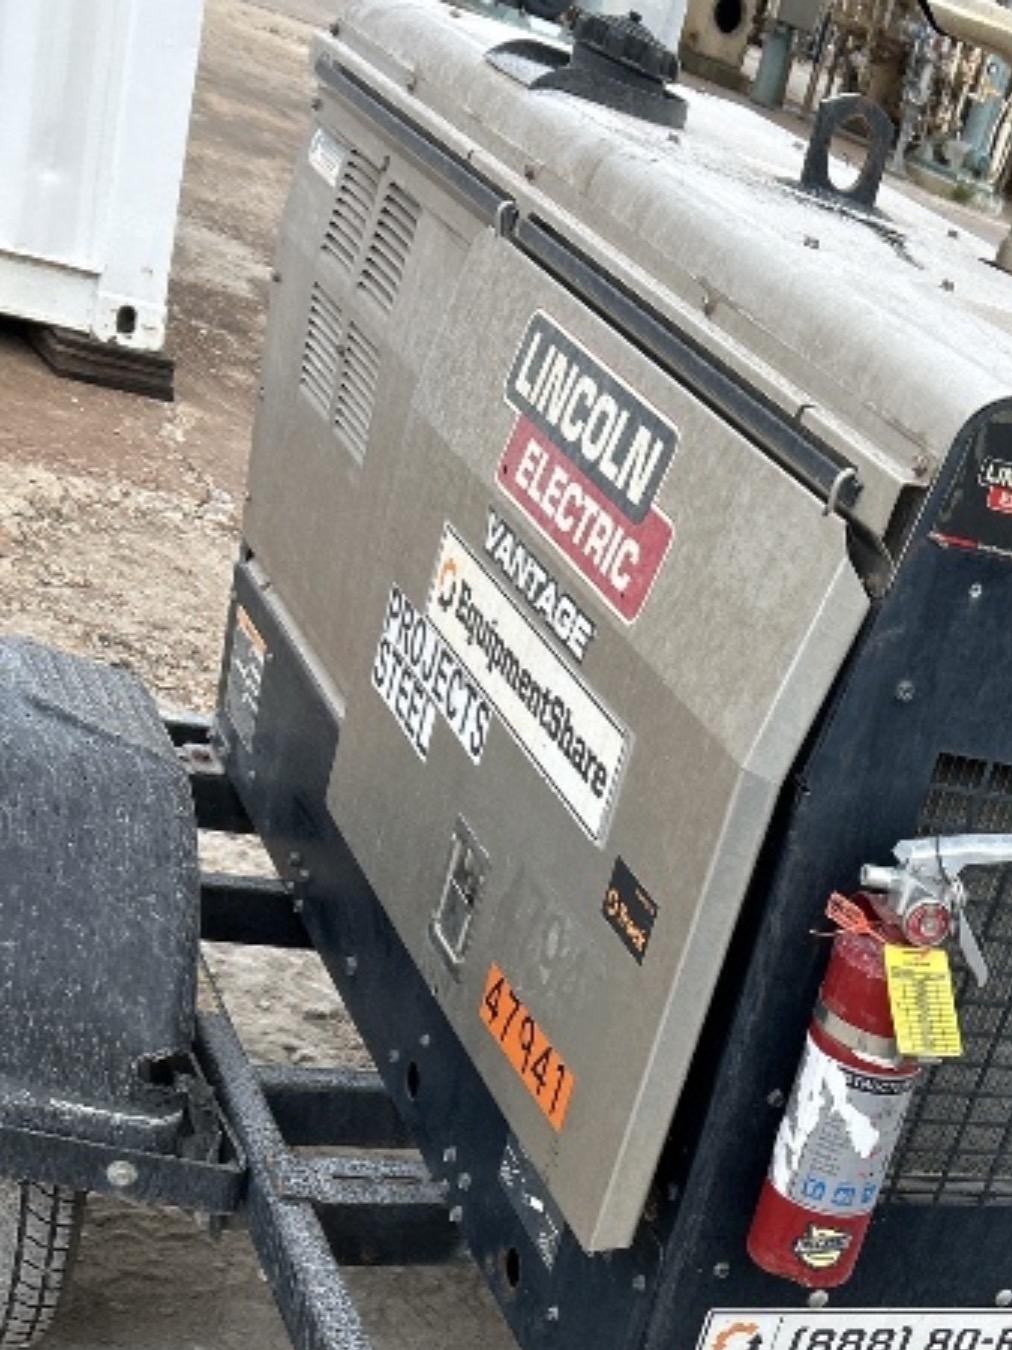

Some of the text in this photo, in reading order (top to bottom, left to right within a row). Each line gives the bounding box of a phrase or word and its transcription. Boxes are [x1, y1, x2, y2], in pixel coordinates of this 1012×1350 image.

[514, 331, 665, 507] LINCOLN
[486, 508, 596, 664] VANTAGE
[514, 437, 640, 593] ELECTRIC
[374, 636, 429, 757] STEEL
[384, 586, 491, 757] PROJECTS
[454, 578, 608, 799] EquipmentShare
[484, 976, 566, 1115] 47941
